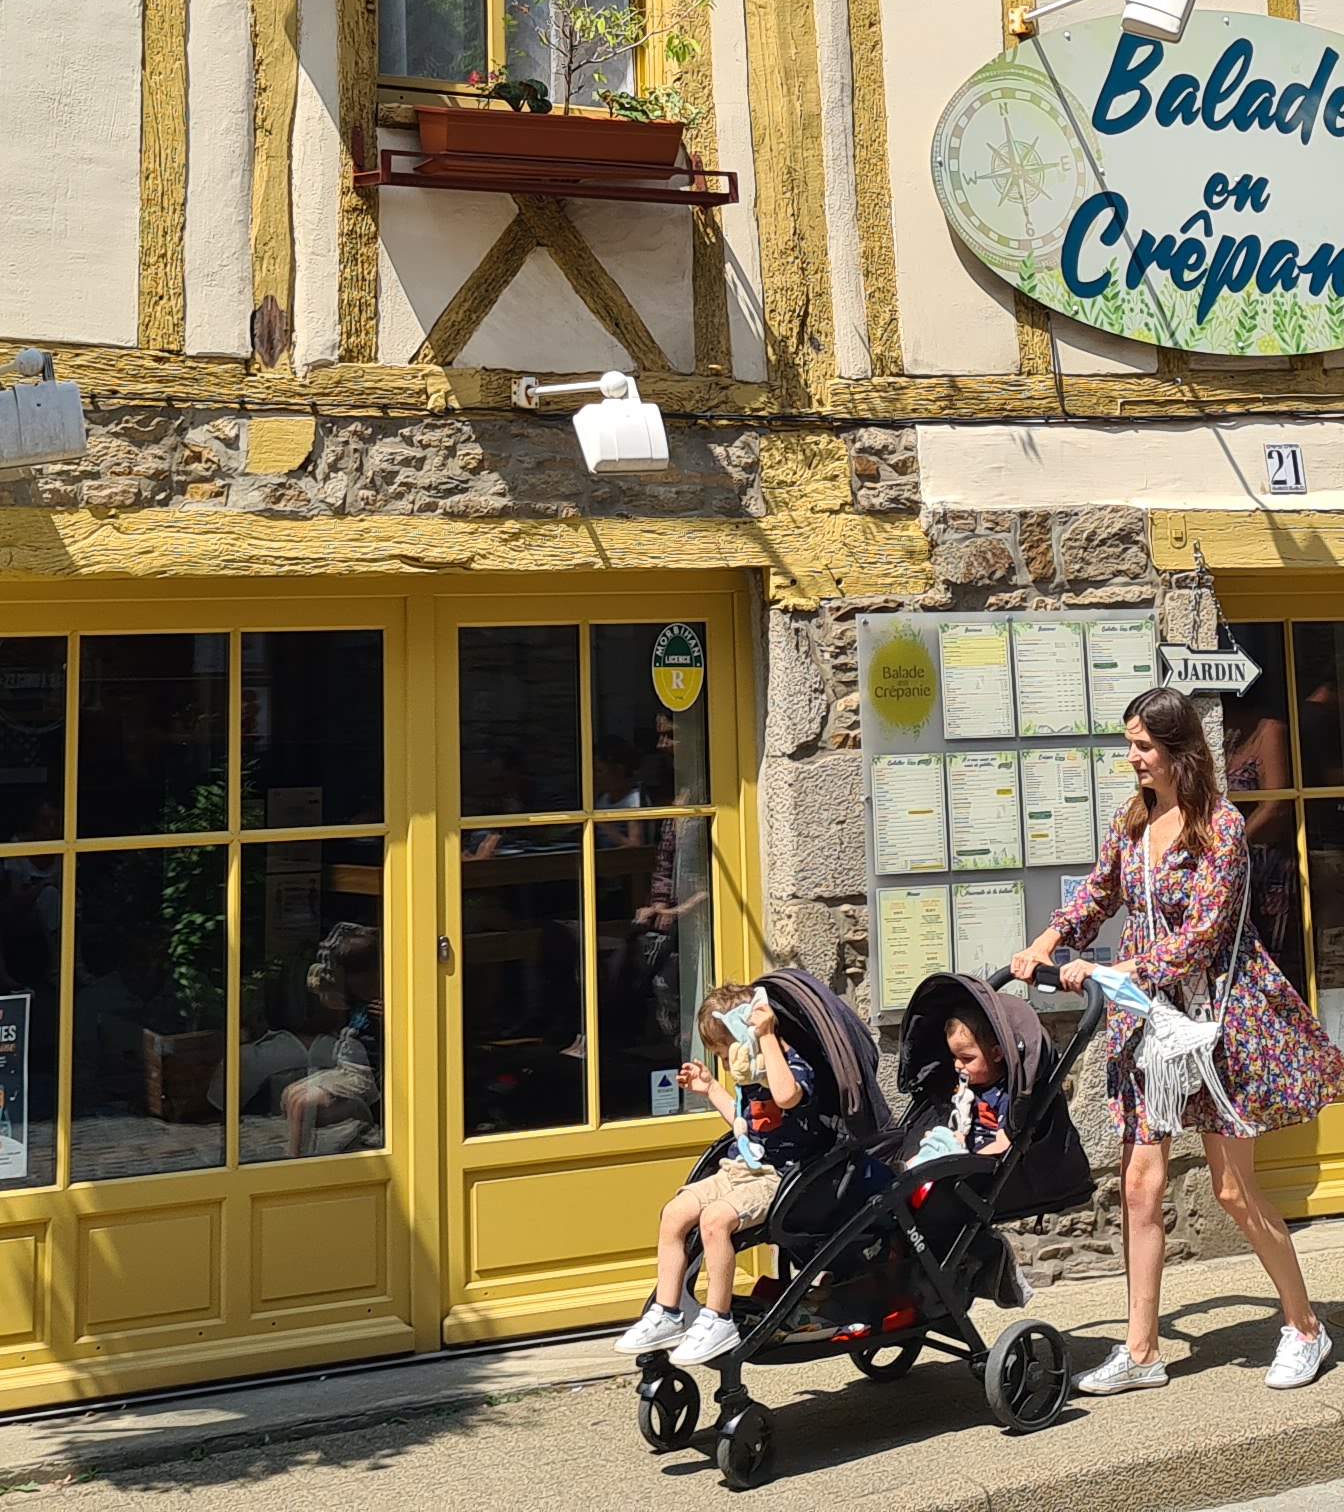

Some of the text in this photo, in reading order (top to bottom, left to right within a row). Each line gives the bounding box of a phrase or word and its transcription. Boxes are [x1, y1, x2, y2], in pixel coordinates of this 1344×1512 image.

[1203, 172, 1271, 213] en
[1267, 449, 1302, 485] 21
[655, 625, 701, 657] MORBIHAN
[665, 655, 691, 664] LICENCE
[1177, 658, 1246, 681] JARDIN
[671, 670, 686, 690] R
[882, 665, 925, 680] Balade
